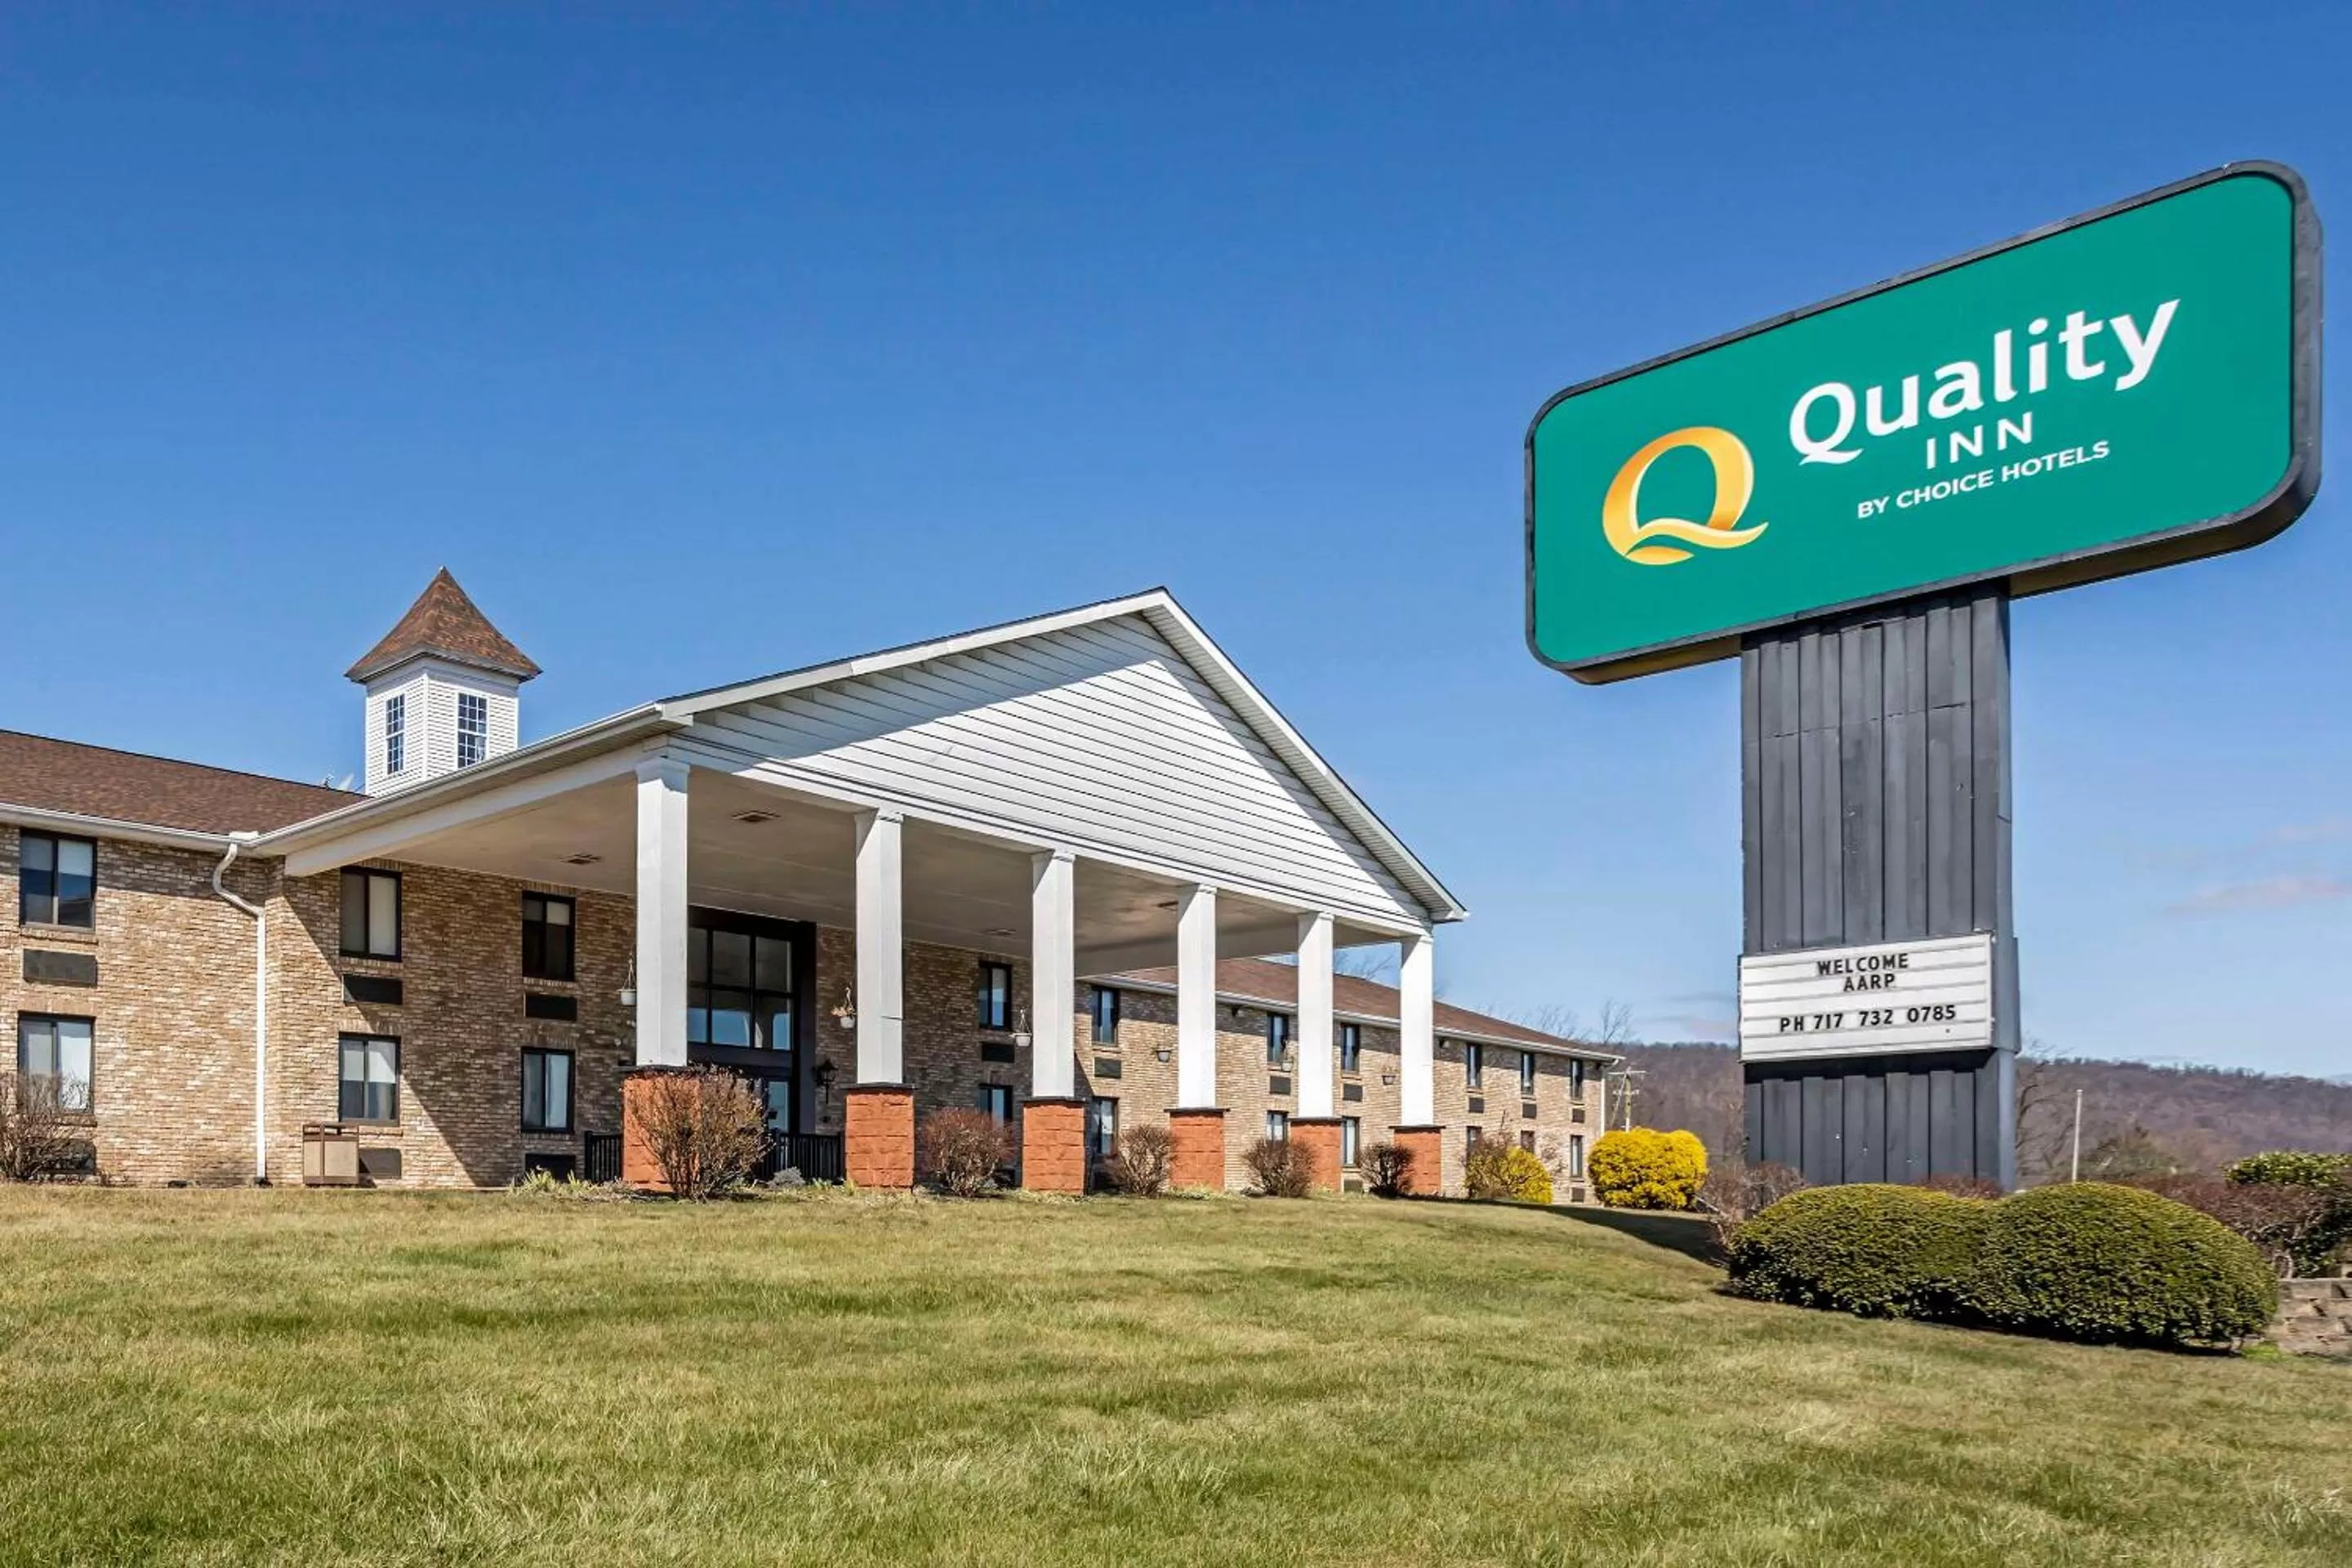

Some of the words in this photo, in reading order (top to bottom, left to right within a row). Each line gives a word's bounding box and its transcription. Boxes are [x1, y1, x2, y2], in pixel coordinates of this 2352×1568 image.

[1789, 299, 2180, 465] Quality
[1927, 412, 2033, 470] INN
[1601, 425, 1769, 566] Q
[1857, 496, 1890, 519] BY
[1896, 470, 1993, 508] CHOICE
[2002, 440, 2110, 482] HOTELS
[1816, 952, 1909, 976] WELCOME
[1843, 973, 1895, 992] AARP
[1780, 1015, 1804, 1033] PH
[1813, 1012, 1843, 1030] 717
[1859, 1009, 1893, 1027] 732
[1907, 1004, 1956, 1023] 0785
